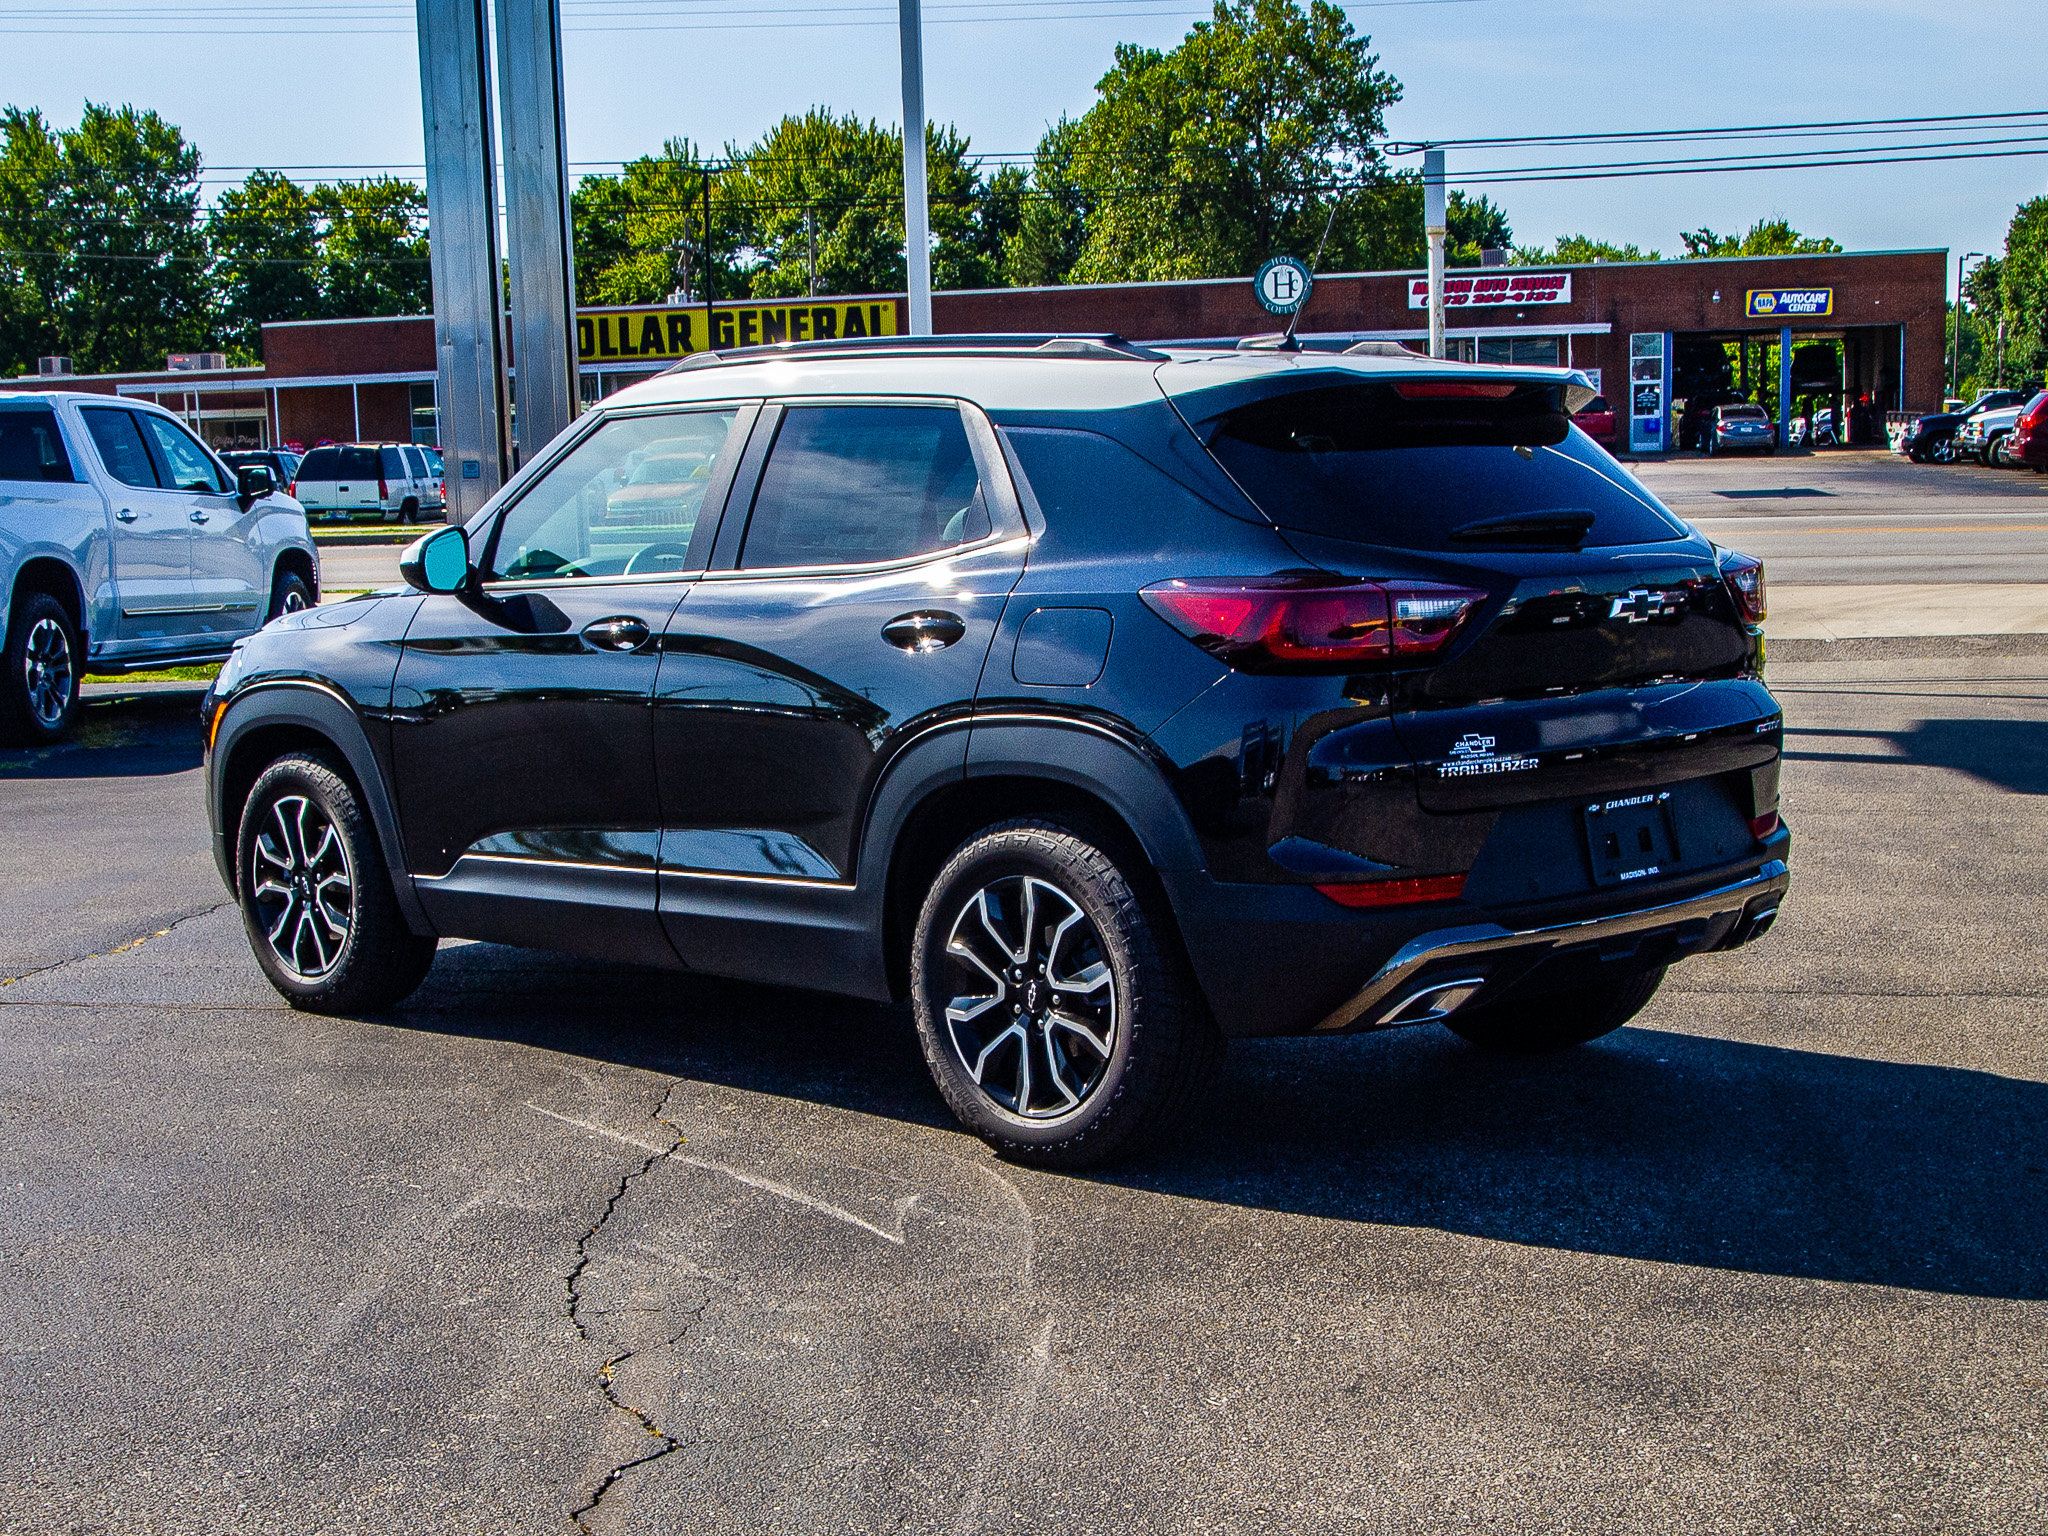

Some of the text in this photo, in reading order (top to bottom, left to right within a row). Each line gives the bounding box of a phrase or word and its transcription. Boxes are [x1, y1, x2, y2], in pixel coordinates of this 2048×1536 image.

[1473, 277, 1509, 293] AUTO
[1509, 275, 1566, 291] SERVICE
[1757, 298, 1773, 308] NAPA
[1788, 303, 1816, 312] CENTER
[1437, 758, 1539, 777] TRAILBLAZER
[1606, 794, 1654, 810] CHANDLER
